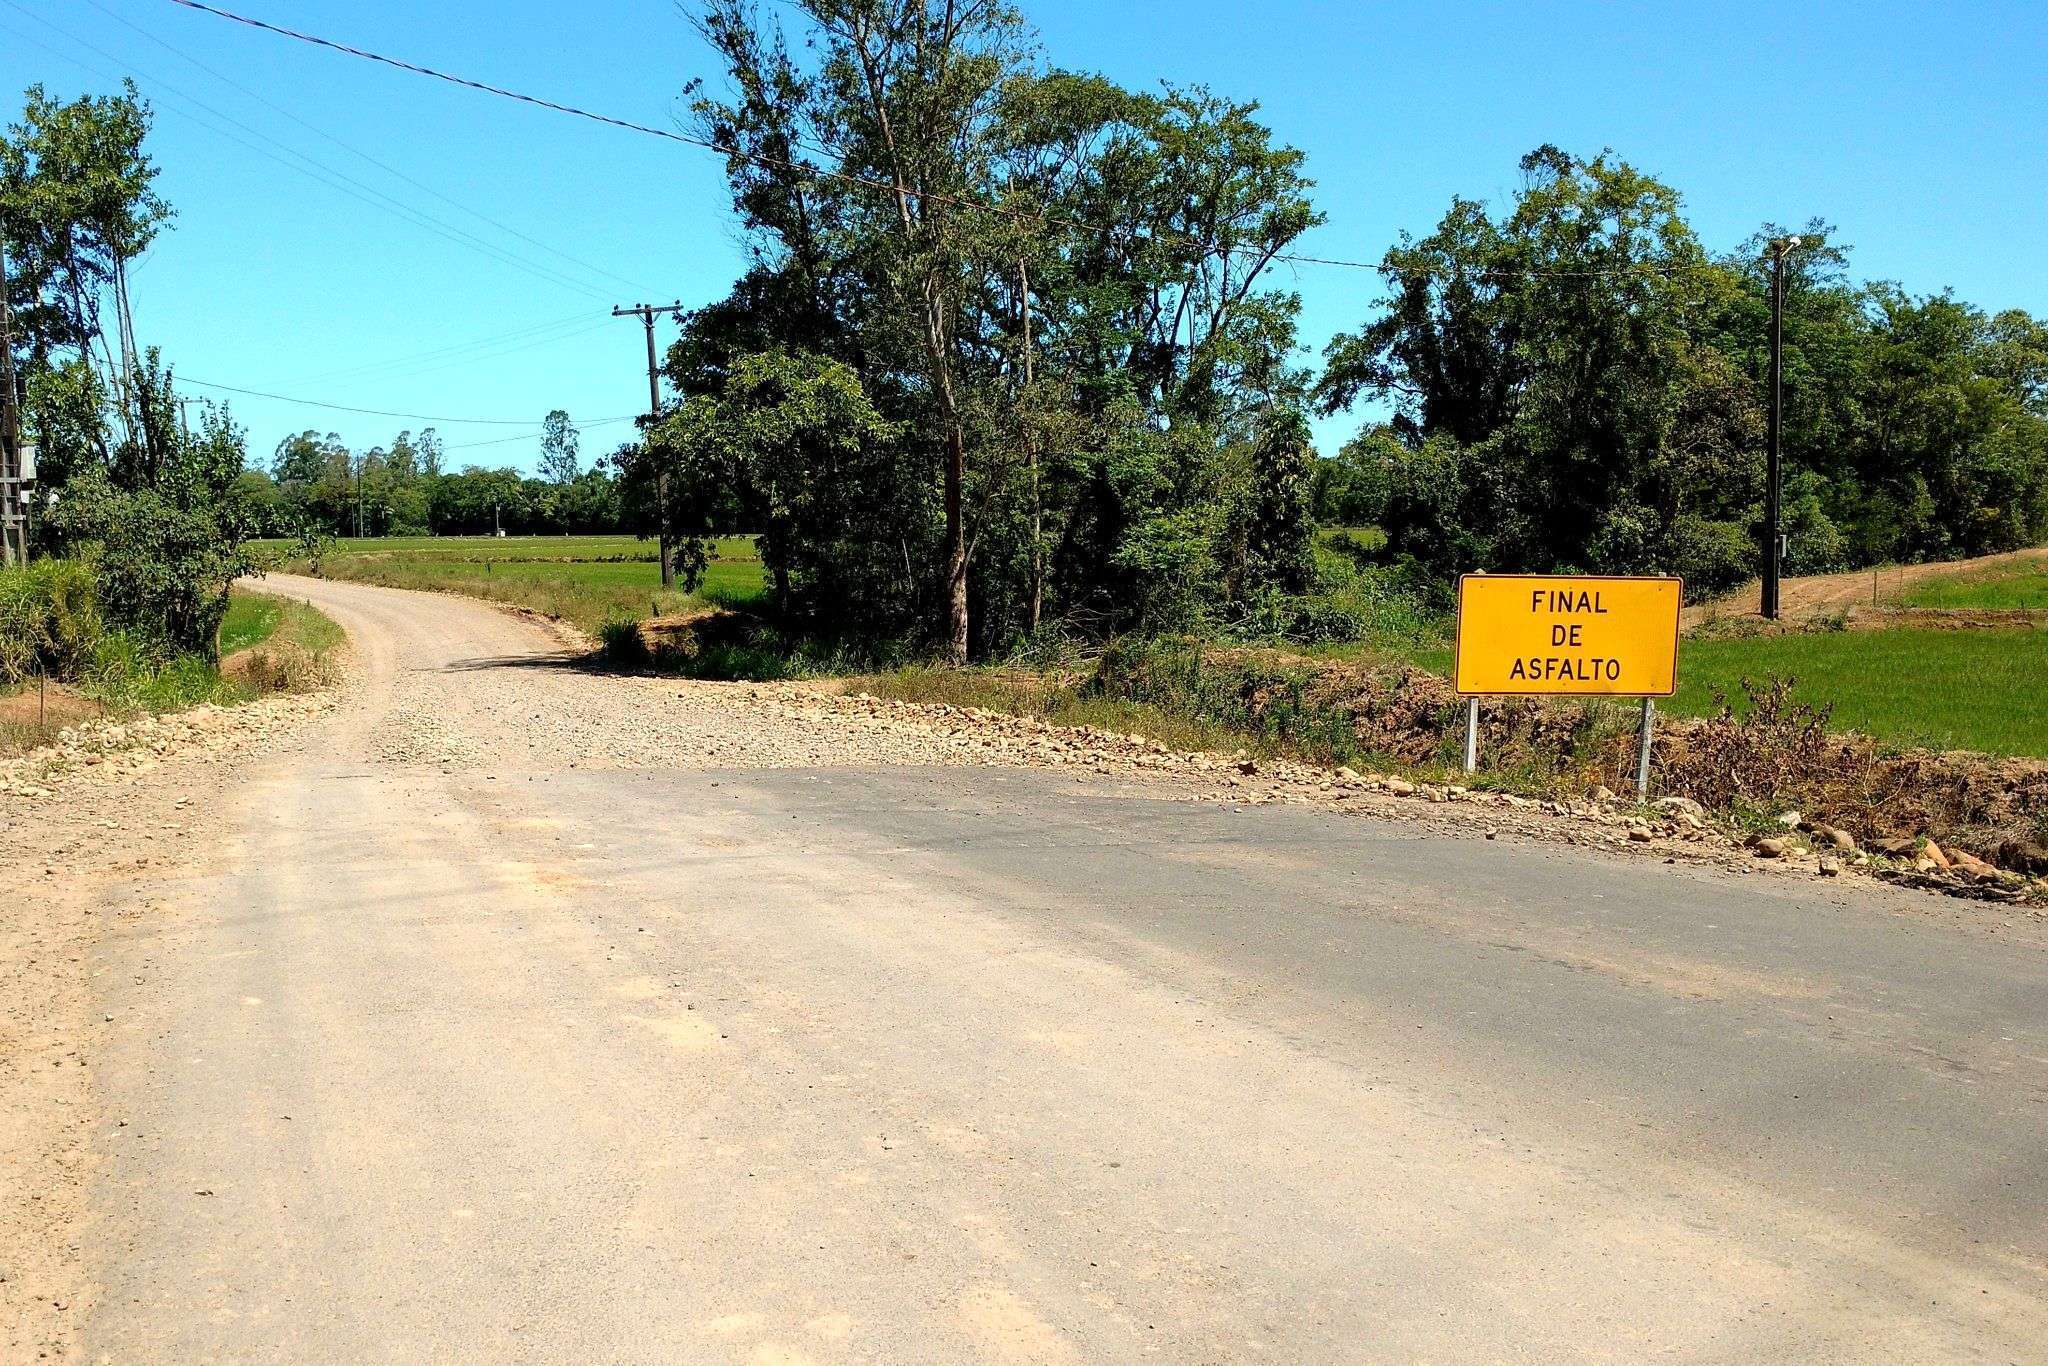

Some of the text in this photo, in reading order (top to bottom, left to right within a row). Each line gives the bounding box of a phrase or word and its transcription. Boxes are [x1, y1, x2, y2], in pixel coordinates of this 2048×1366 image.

[1532, 590, 1608, 614] FINAL
[1551, 624, 1583, 647] DE
[1509, 657, 1620, 681] ASFALTO
